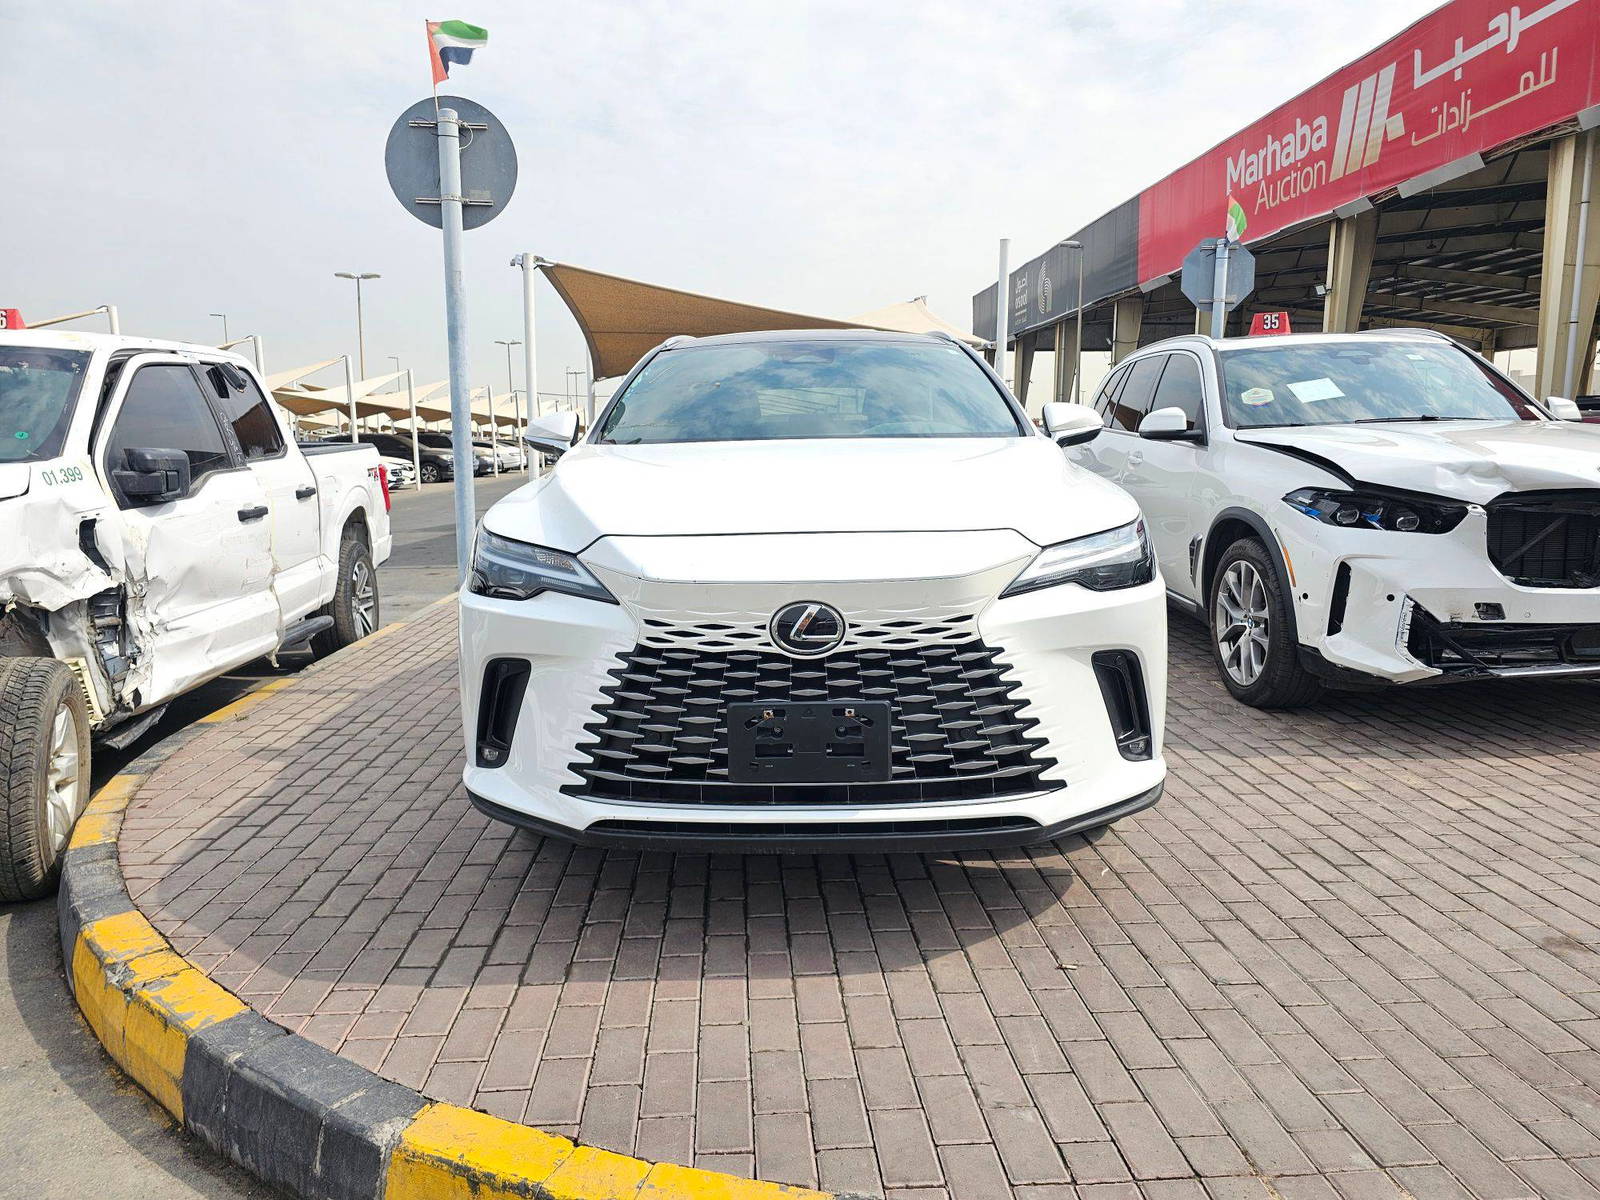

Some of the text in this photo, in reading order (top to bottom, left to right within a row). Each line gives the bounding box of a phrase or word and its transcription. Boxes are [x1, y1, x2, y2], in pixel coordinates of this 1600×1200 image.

[1413, 0, 1580, 90] رحبا
[1411, 46, 1558, 147] للمزادات
[1226, 115, 1327, 195] Marhaba
[1254, 160, 1326, 215] Auction
[1263, 314, 1280, 330] 35
[42, 466, 83, 486] 01.399
